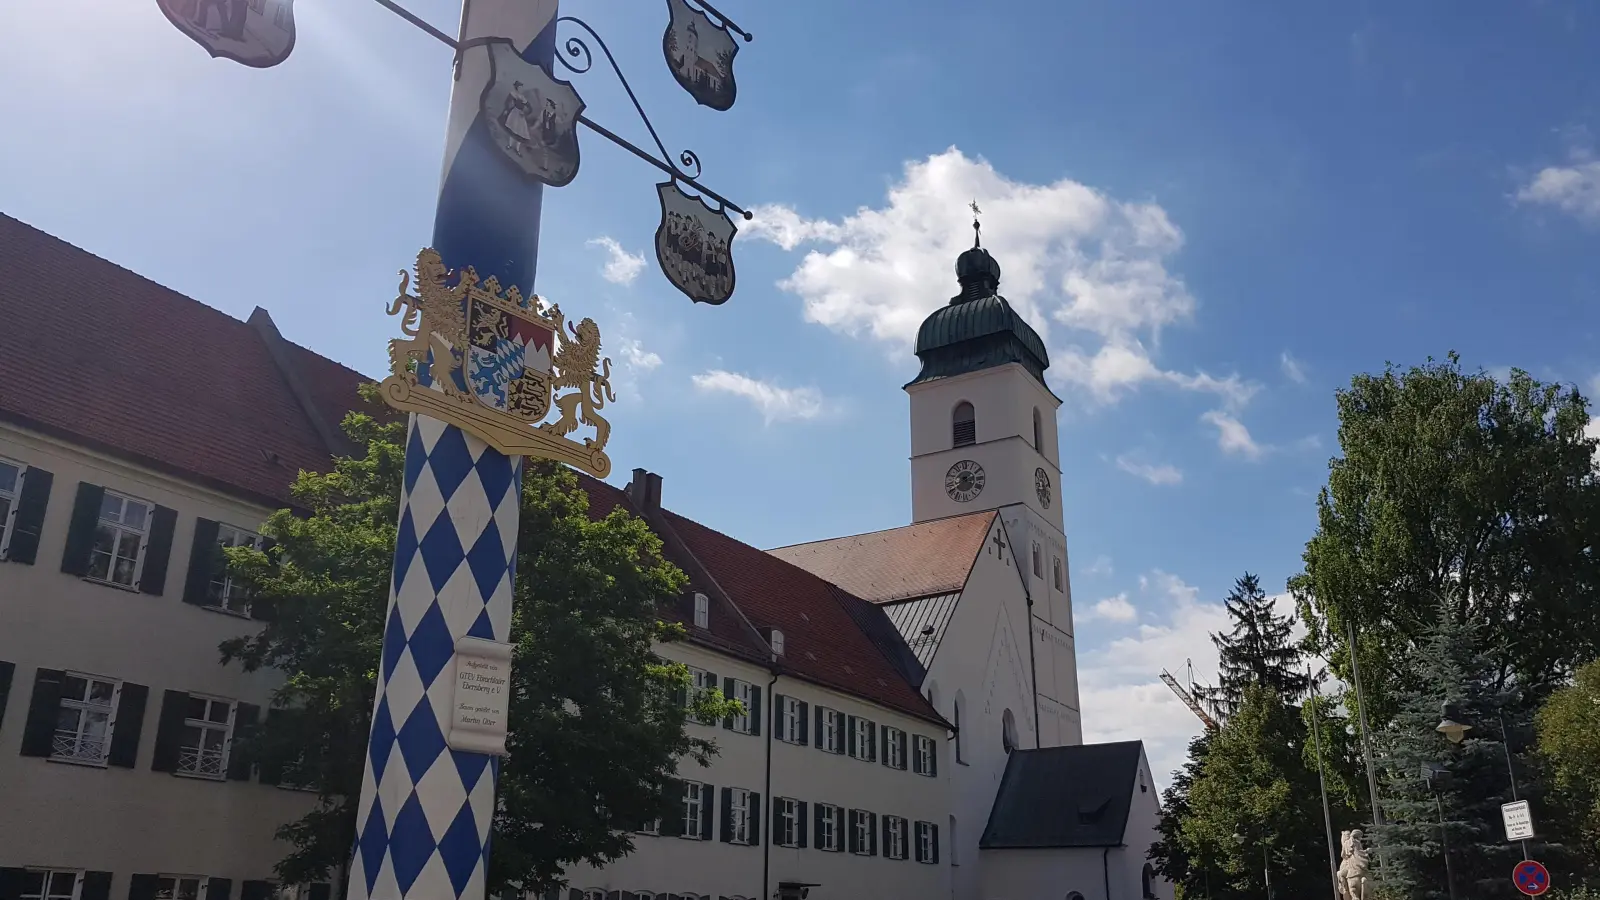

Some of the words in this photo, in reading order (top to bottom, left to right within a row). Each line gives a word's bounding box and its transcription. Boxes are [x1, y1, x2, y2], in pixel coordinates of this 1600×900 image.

[460, 672, 475, 680] GTEV
[462, 682, 490, 694] Ebersberg
[461, 715, 480, 724] Martin
